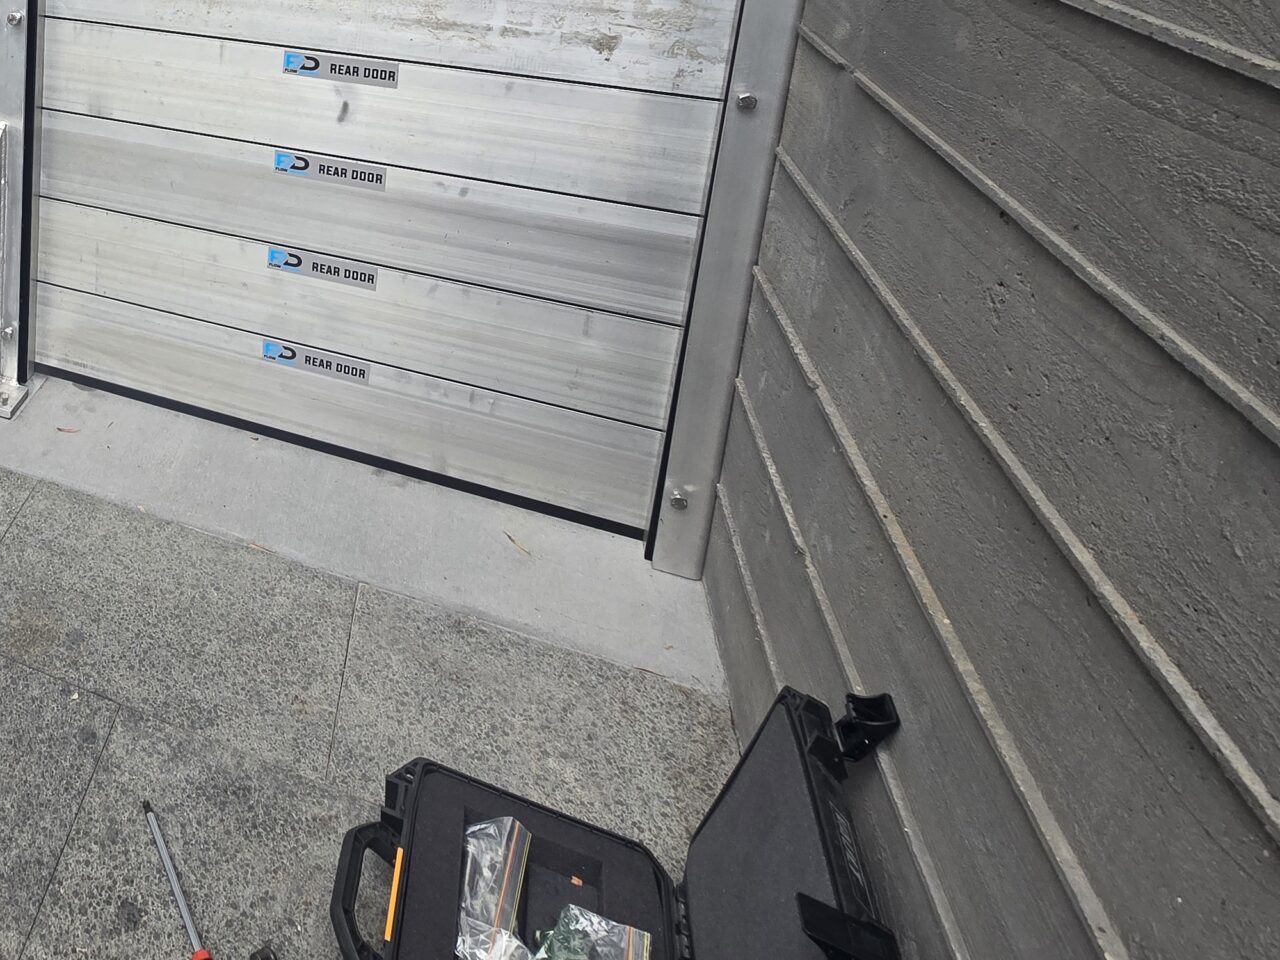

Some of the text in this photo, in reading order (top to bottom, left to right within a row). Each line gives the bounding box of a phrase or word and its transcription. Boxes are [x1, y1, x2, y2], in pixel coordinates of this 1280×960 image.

[330, 63, 359, 77] REAR
[364, 68, 396, 82] DOOR
[319, 164, 347, 178] REAR
[351, 169, 383, 184] DOOR
[312, 262, 375, 284] REAR DOOR
[305, 356, 366, 379] REAR DOOR
